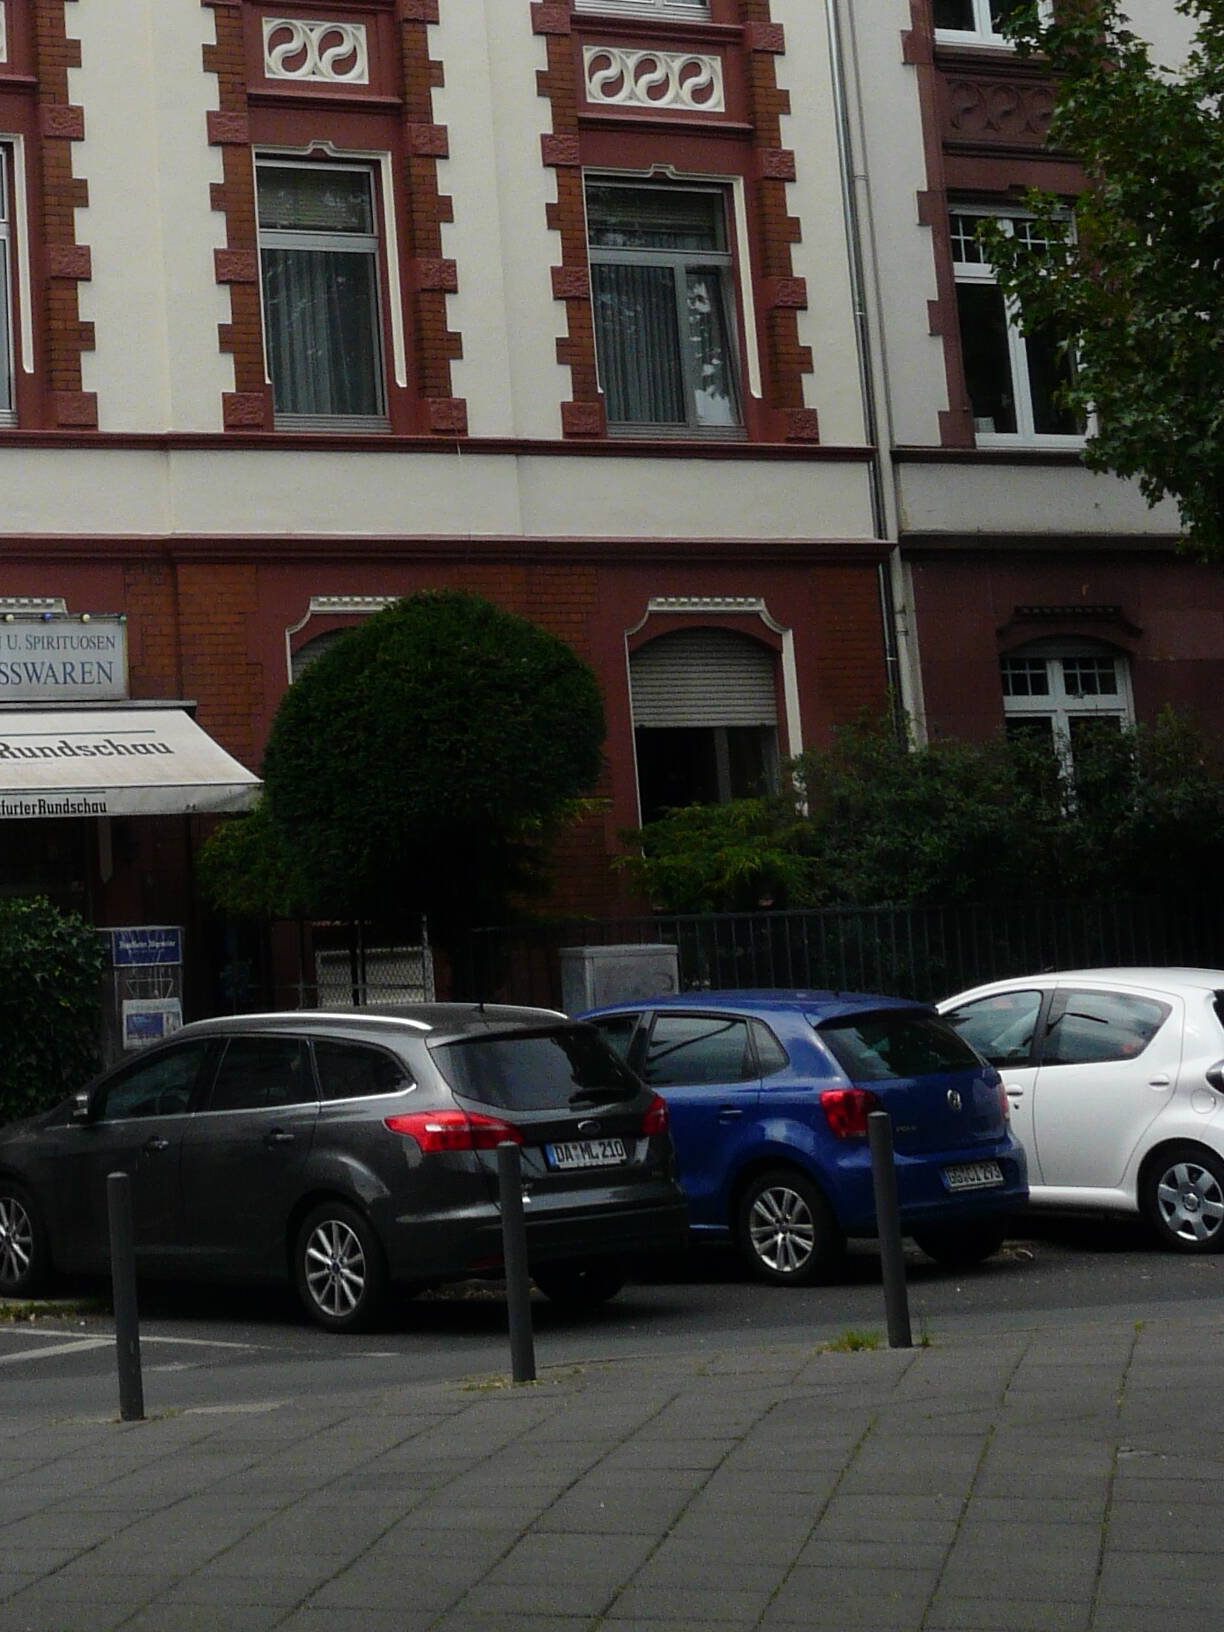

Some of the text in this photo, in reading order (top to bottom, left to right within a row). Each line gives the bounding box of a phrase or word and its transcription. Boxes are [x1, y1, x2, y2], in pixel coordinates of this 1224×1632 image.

[6, 634, 22, 650] U.
[25, 634, 116, 650] SPIRITUOSEN
[555, 1140, 625, 1163] DA ML 210
